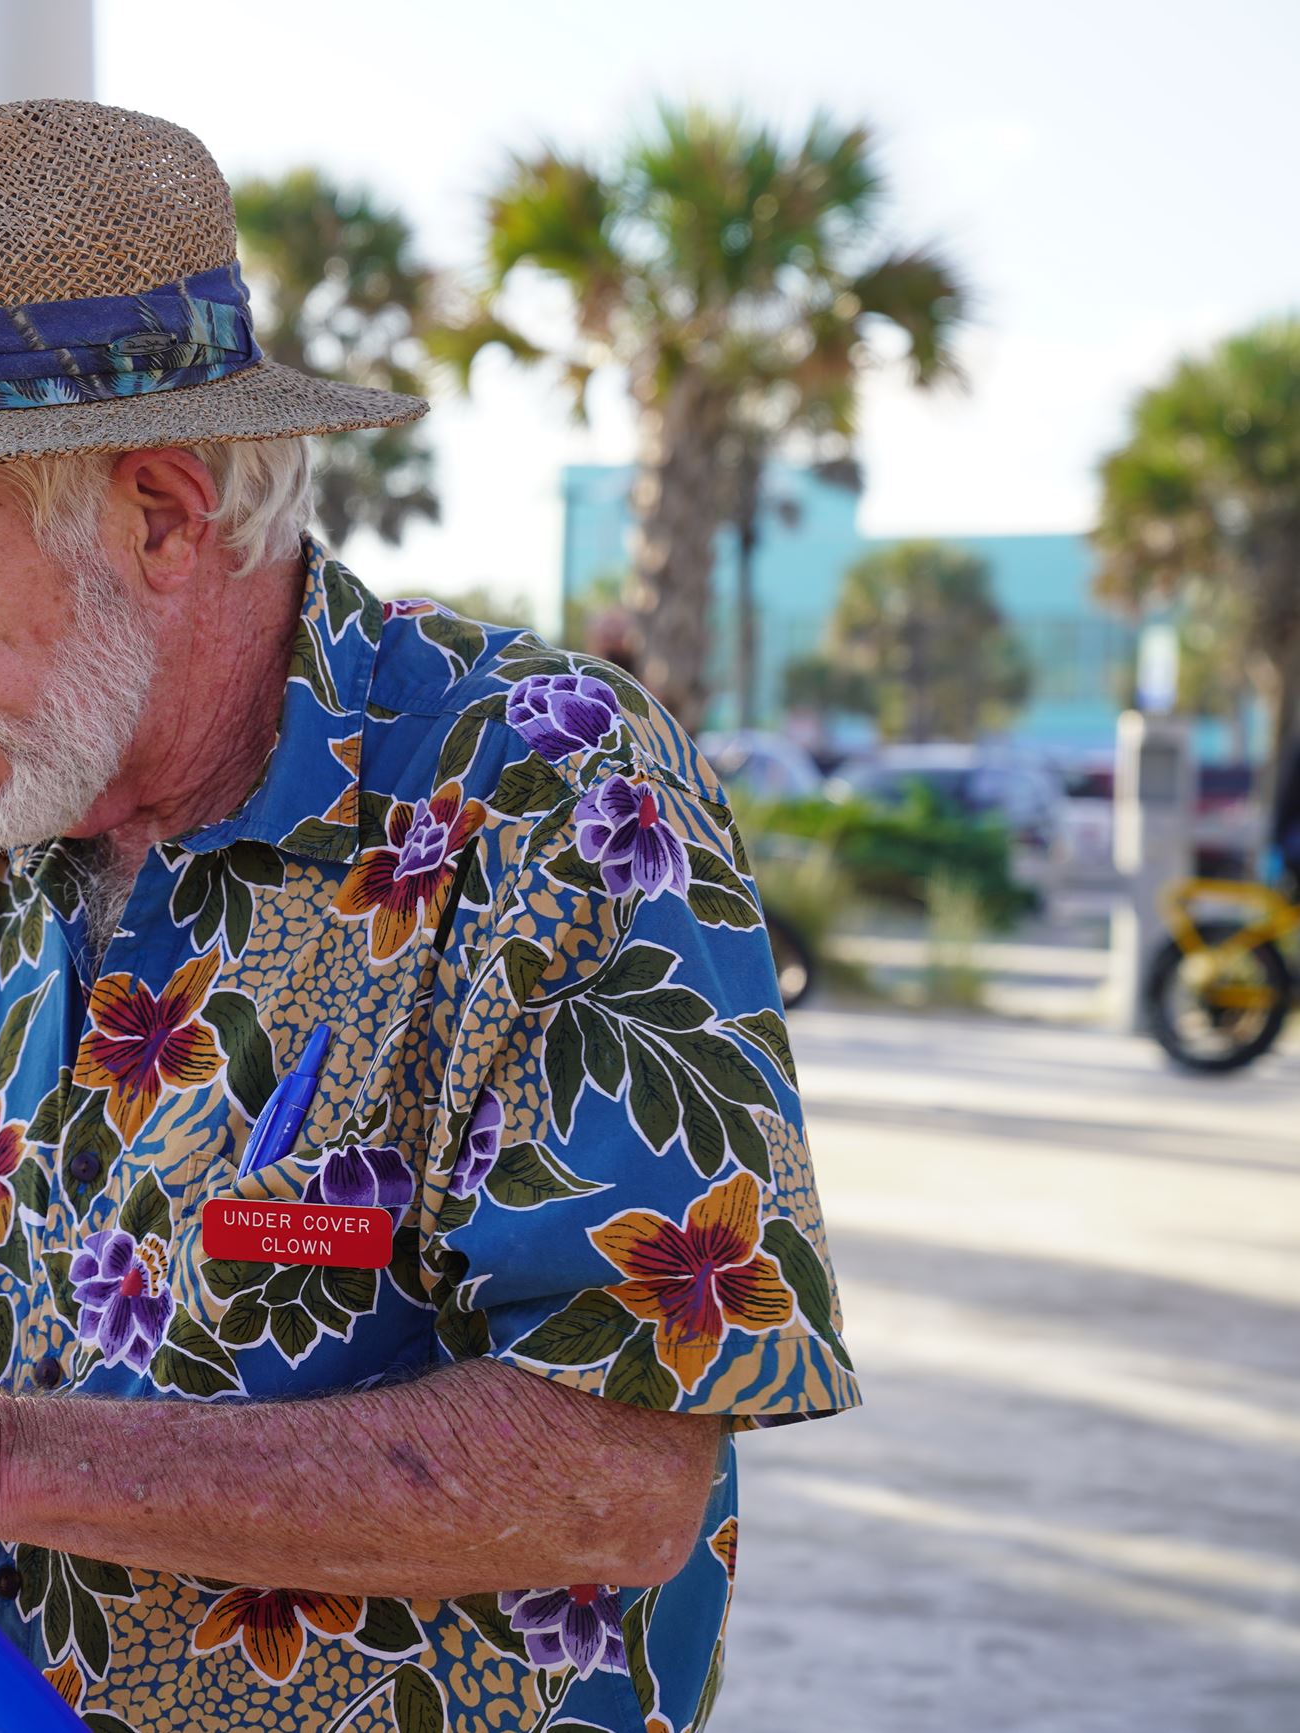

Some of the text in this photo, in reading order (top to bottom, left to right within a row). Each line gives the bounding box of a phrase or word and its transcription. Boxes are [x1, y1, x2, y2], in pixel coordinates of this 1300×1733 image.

[223, 1210, 370, 1234] UNDER COVER
[261, 1237, 332, 1256] CLOWN
